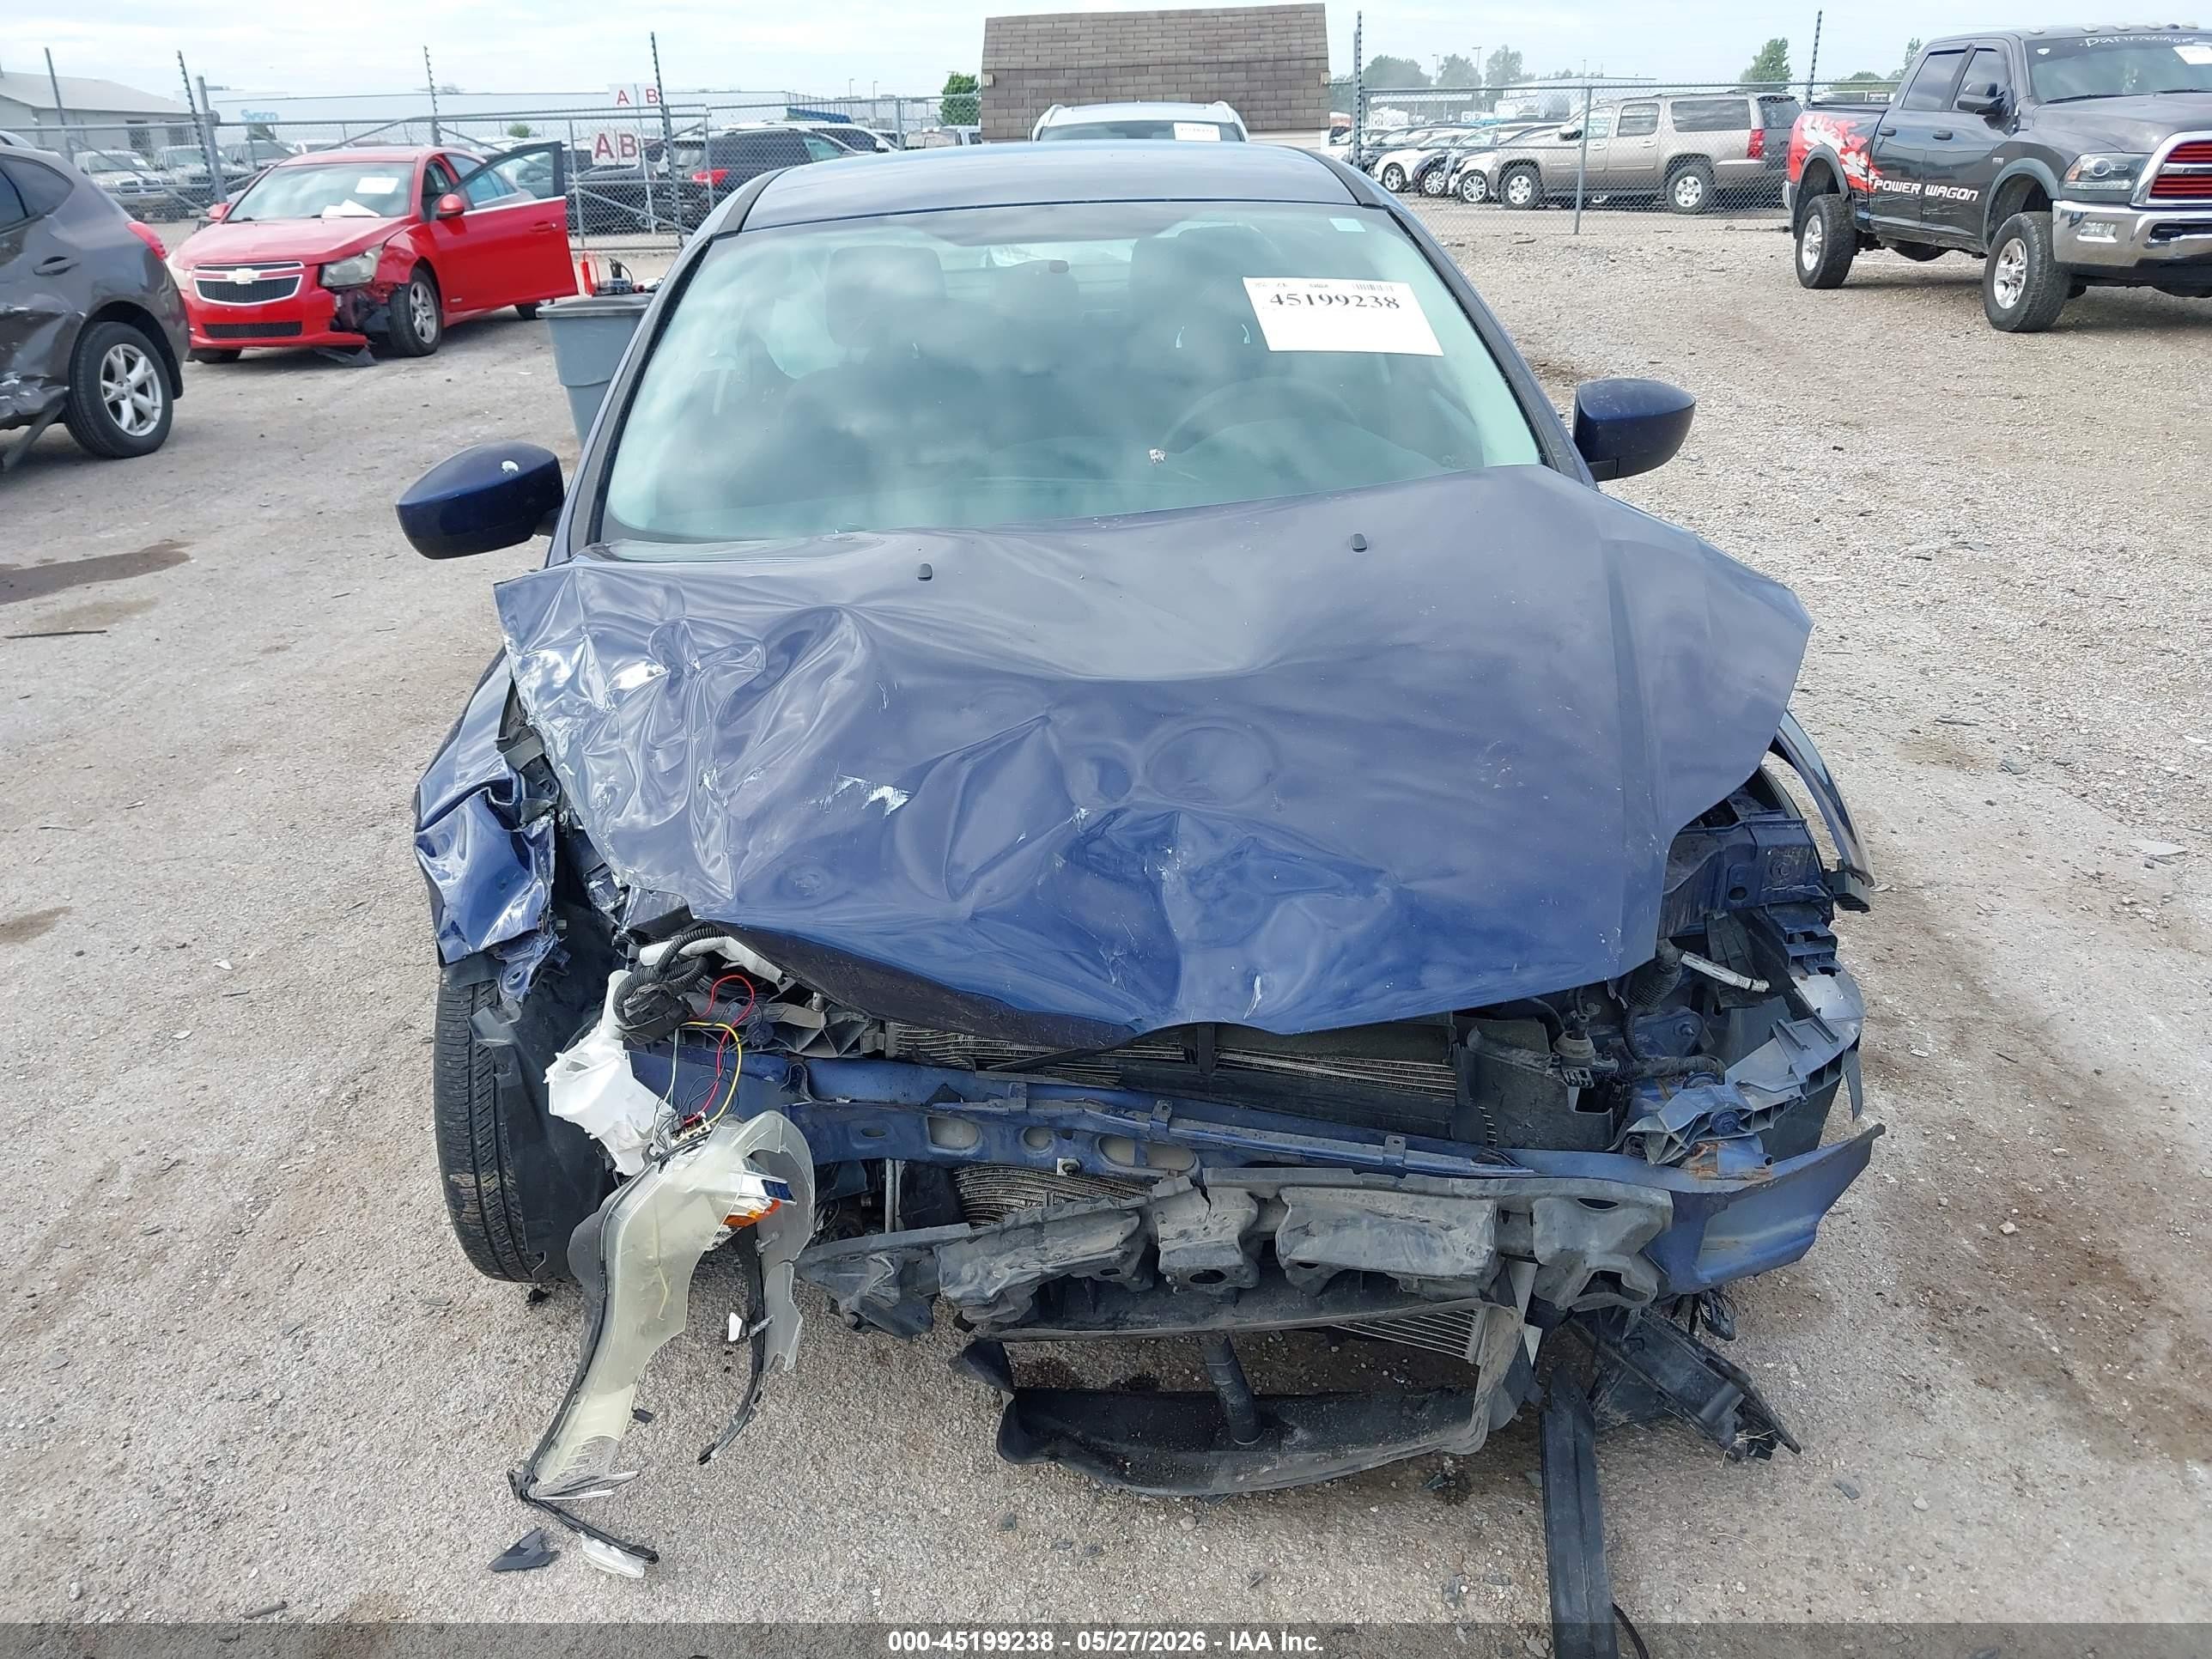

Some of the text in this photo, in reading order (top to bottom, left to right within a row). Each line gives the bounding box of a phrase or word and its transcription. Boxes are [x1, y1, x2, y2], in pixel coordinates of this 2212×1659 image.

[617, 88, 659, 105] A B
[594, 133, 637, 159] A B
[1873, 179, 1979, 202] POWER WAGON
[1269, 293, 1401, 310] 45199238
